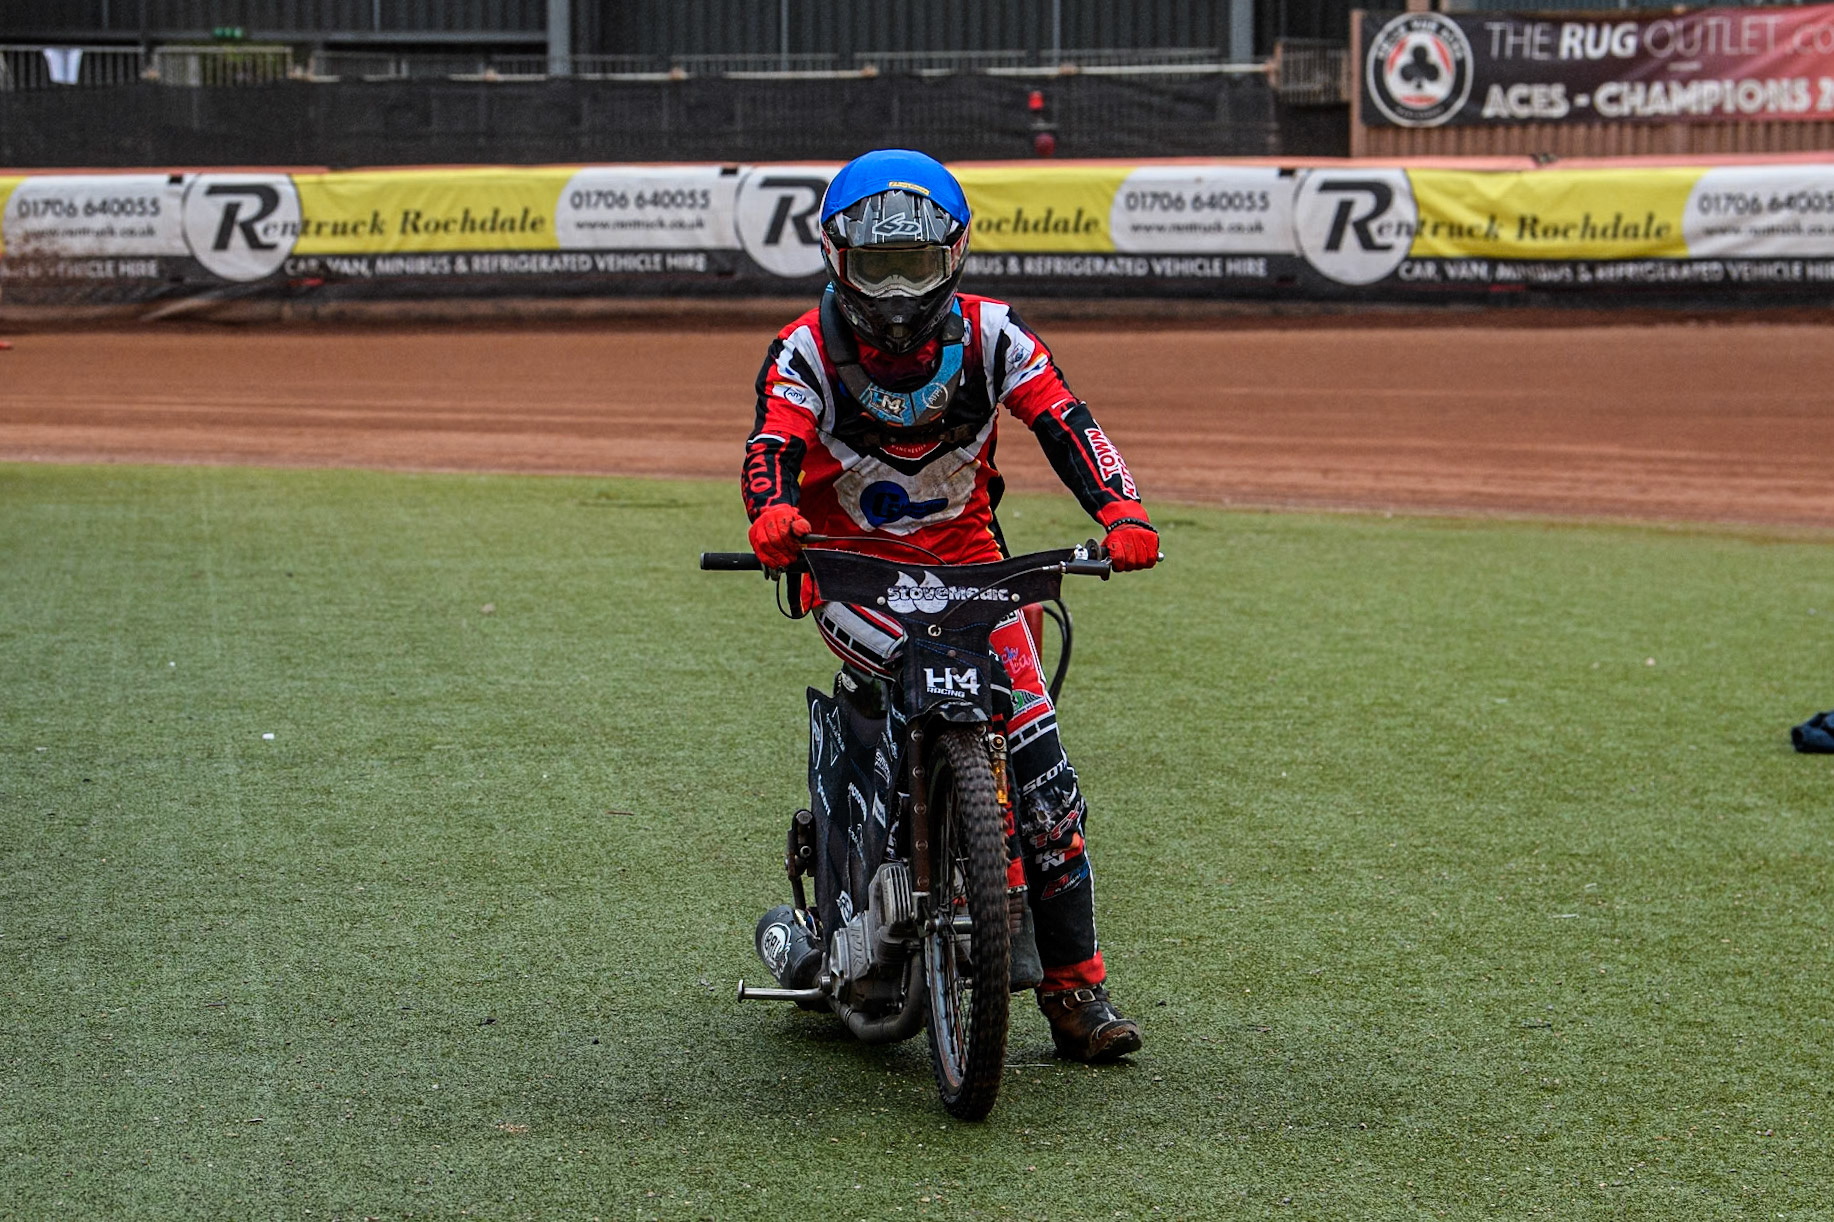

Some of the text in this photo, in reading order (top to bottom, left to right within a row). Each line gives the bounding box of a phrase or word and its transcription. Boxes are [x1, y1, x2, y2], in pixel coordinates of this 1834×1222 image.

[1484, 20, 1551, 60] THE
[1558, 21, 1639, 60] RUG
[1481, 82, 1570, 119] ACES
[1573, 93, 1590, 107] -
[1594, 77, 1811, 117] CHAMPIONS
[1817, 75, 1834, 112] 2
[17, 197, 161, 218] 01706 640055
[570, 189, 711, 210] 01706 640055
[1124, 190, 1270, 212] 01706 640055
[1698, 192, 1764, 215] 01706
[400, 205, 546, 236] Rochdale
[971, 206, 1099, 236] ochdale
[1516, 210, 1672, 240] Rochdale
[118, 258, 160, 278] HIRE
[374, 254, 451, 275] MINIBUS
[454, 254, 468, 274] &
[470, 252, 594, 274] REFRIGERATED
[596, 253, 663, 273] VEHICLE
[665, 252, 707, 272] HIRE
[1004, 256, 1020, 276] &
[1022, 256, 1149, 276] REFRIGERATED
[1150, 256, 1224, 277] VEHICLE
[1225, 256, 1268, 277] HIRE
[1085, 428, 1112, 481] TOWN
[926, 687, 966, 699] RACING
